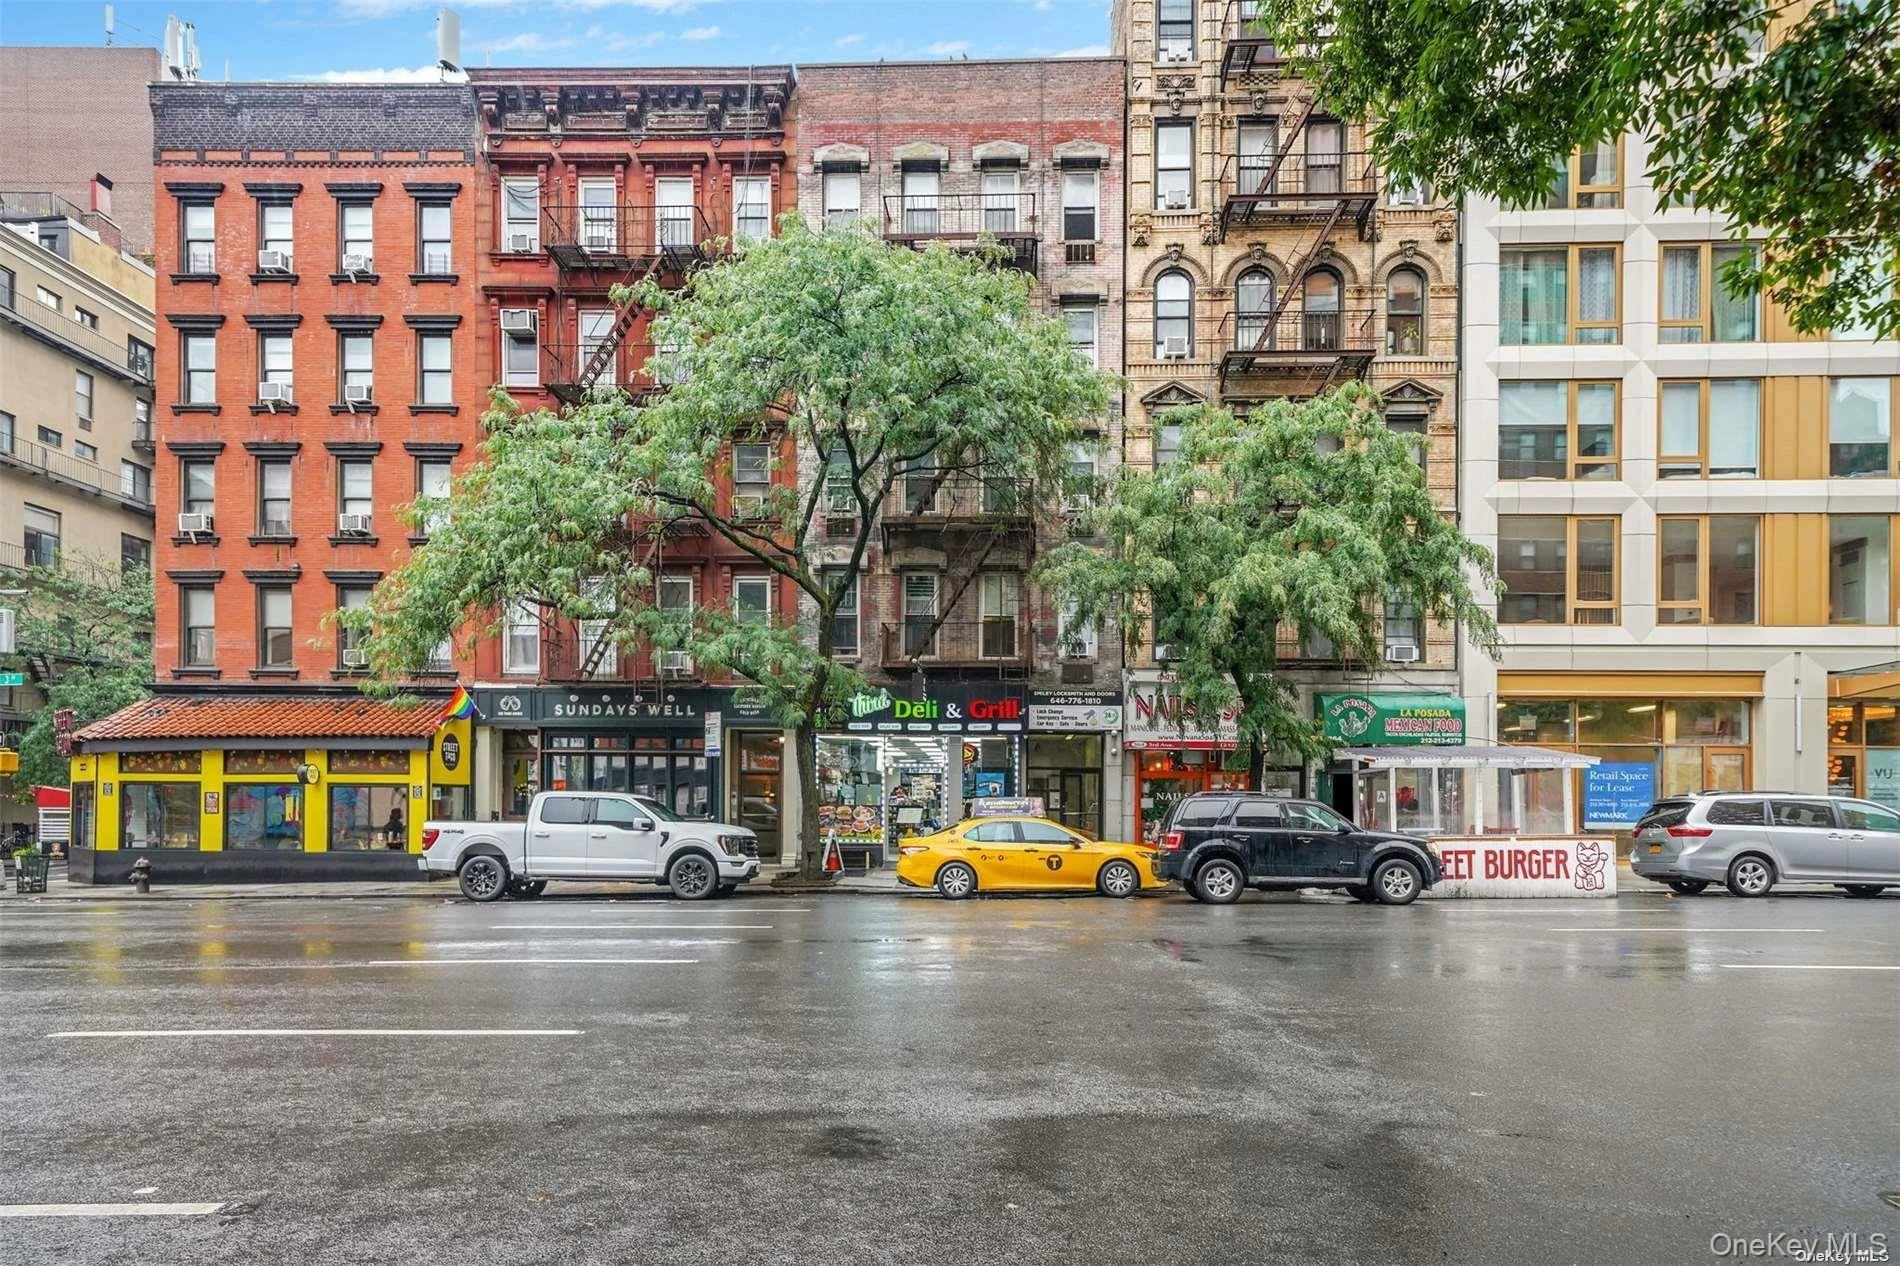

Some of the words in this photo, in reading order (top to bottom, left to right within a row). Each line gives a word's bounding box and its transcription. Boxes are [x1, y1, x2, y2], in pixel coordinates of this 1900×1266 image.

[1050, 697, 1102, 705] 646-776-1810
[554, 704, 638, 717] SUNDAYS
[648, 704, 696, 716] WELL
[895, 700, 938, 720] Deli
[946, 703, 963, 719] &
[969, 699, 1019, 720] Grill
[1400, 709, 1412, 717] LA
[1414, 709, 1451, 718] POSADA
[1384, 718, 1432, 732] MEXICAN
[1433, 718, 1463, 732] FOOD
[1590, 770, 1618, 780] Retail
[1620, 770, 1649, 783] Space
[1590, 783, 1605, 792] for
[1608, 783, 1636, 792] Lease
[1589, 811, 1629, 819] NEWMARK
[1485, 850, 1570, 880] BURGER
